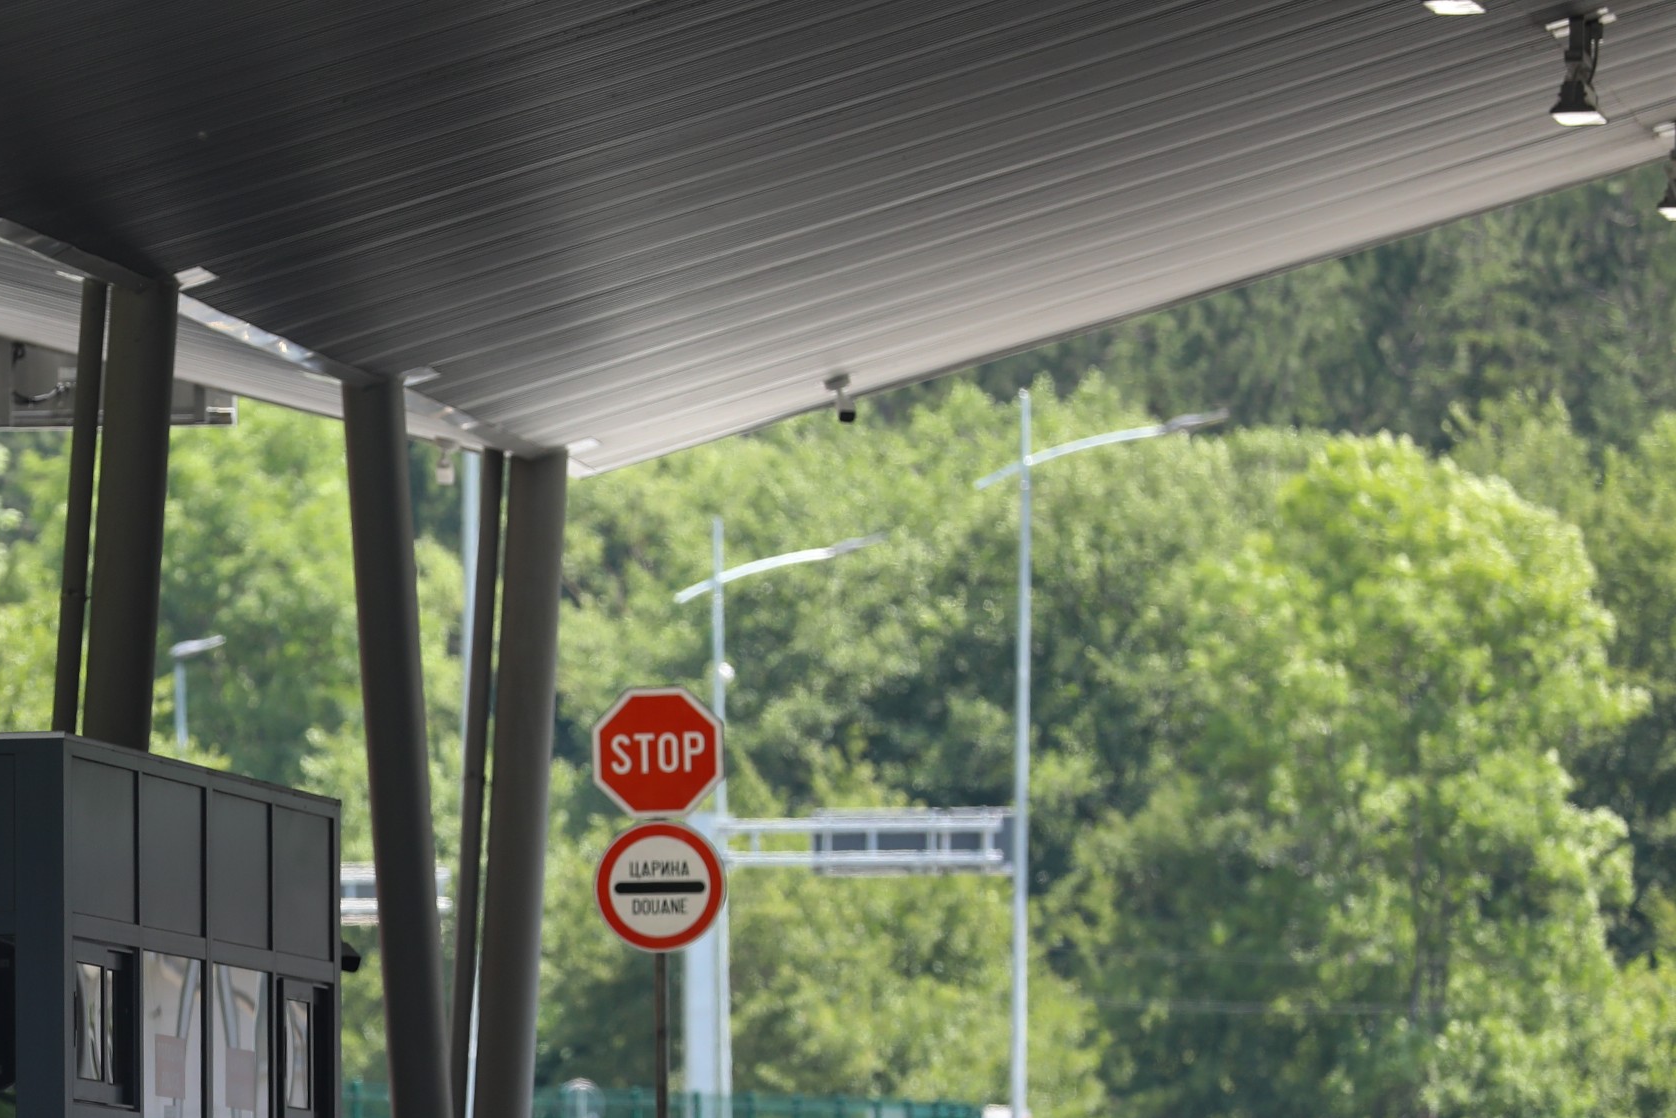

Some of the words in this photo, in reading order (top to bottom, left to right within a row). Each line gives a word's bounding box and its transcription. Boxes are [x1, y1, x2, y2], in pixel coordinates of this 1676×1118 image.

[610, 730, 706, 775] STOP
[629, 860, 690, 879] ЦАРИНА
[632, 898, 688, 916] DOUANE
